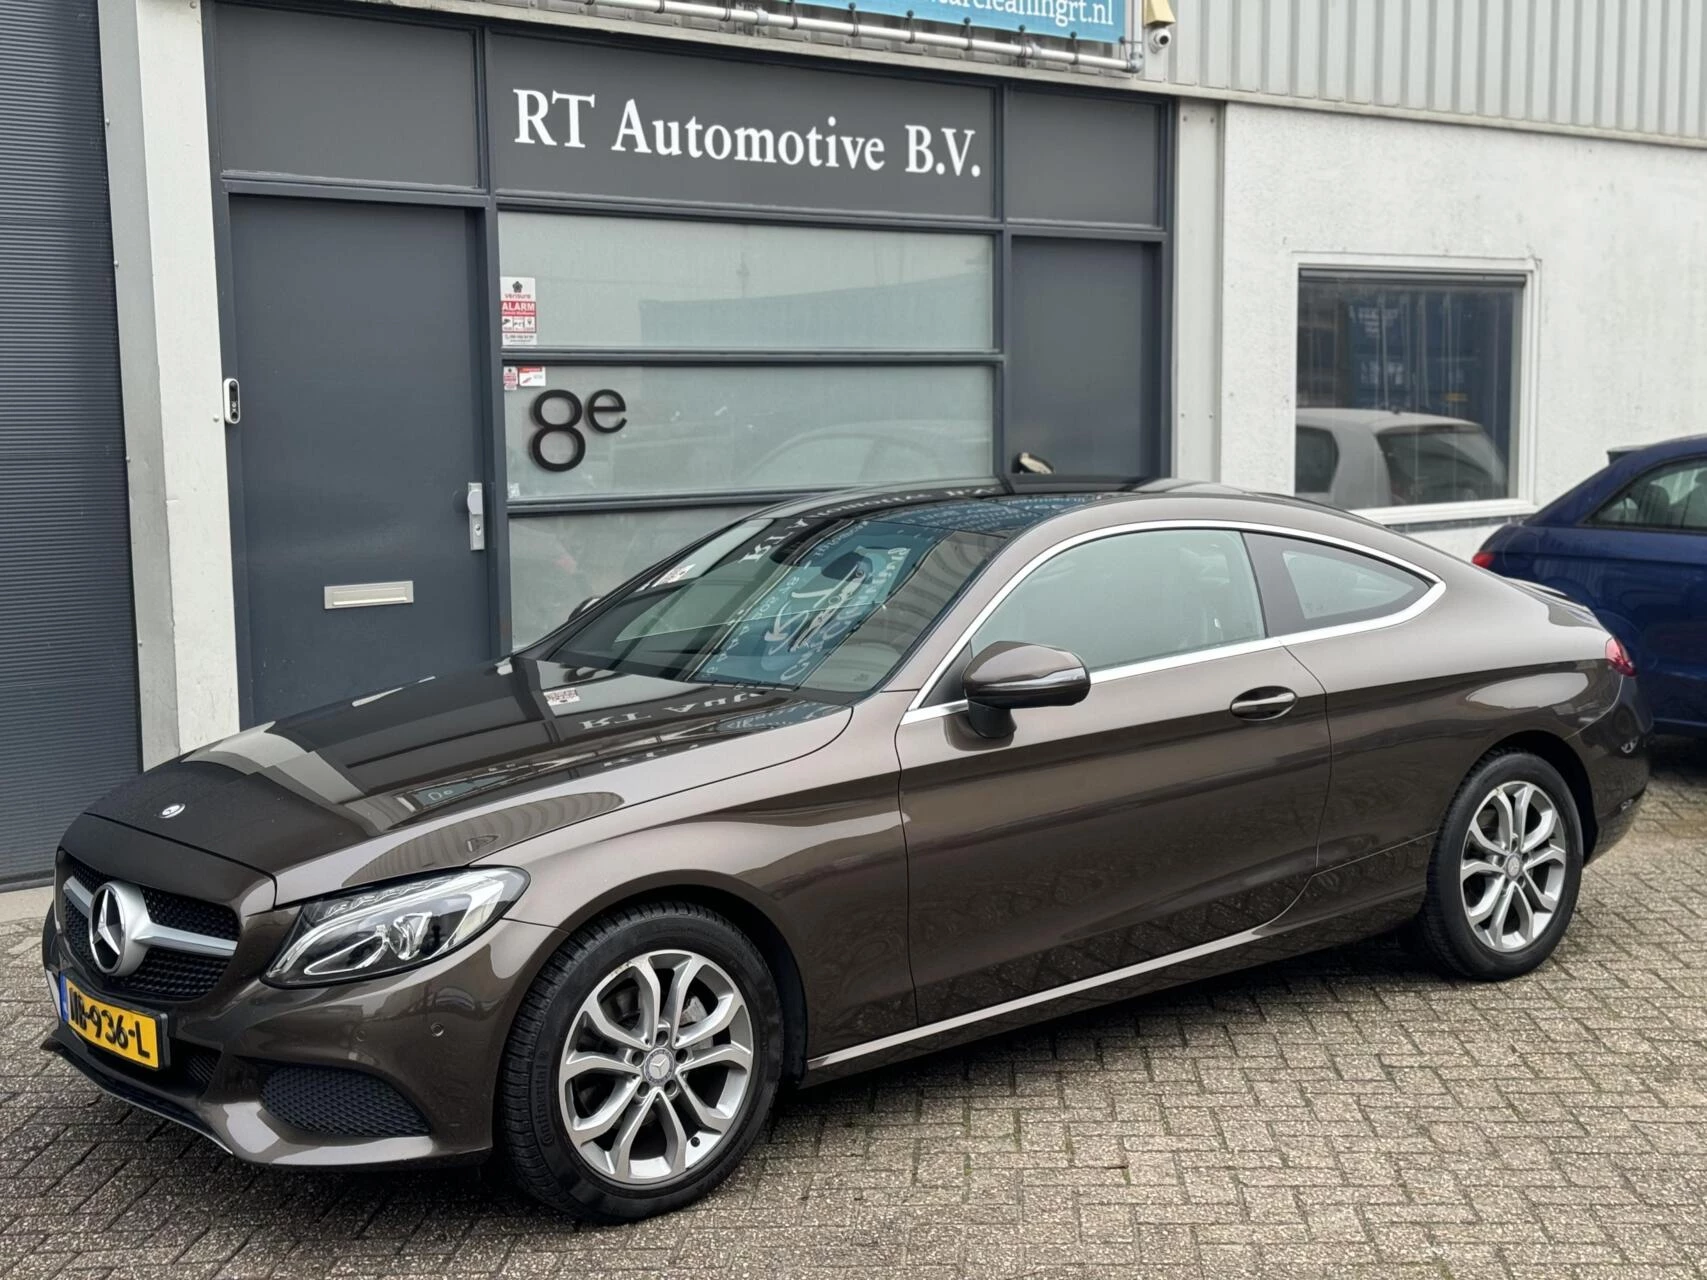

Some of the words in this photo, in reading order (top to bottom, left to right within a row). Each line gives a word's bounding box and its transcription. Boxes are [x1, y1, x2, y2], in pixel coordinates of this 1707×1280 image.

[512, 88, 595, 148] RT
[611, 98, 885, 171] Automotive
[904, 124, 981, 177] B.V.
[502, 302, 535, 311] ALARM
